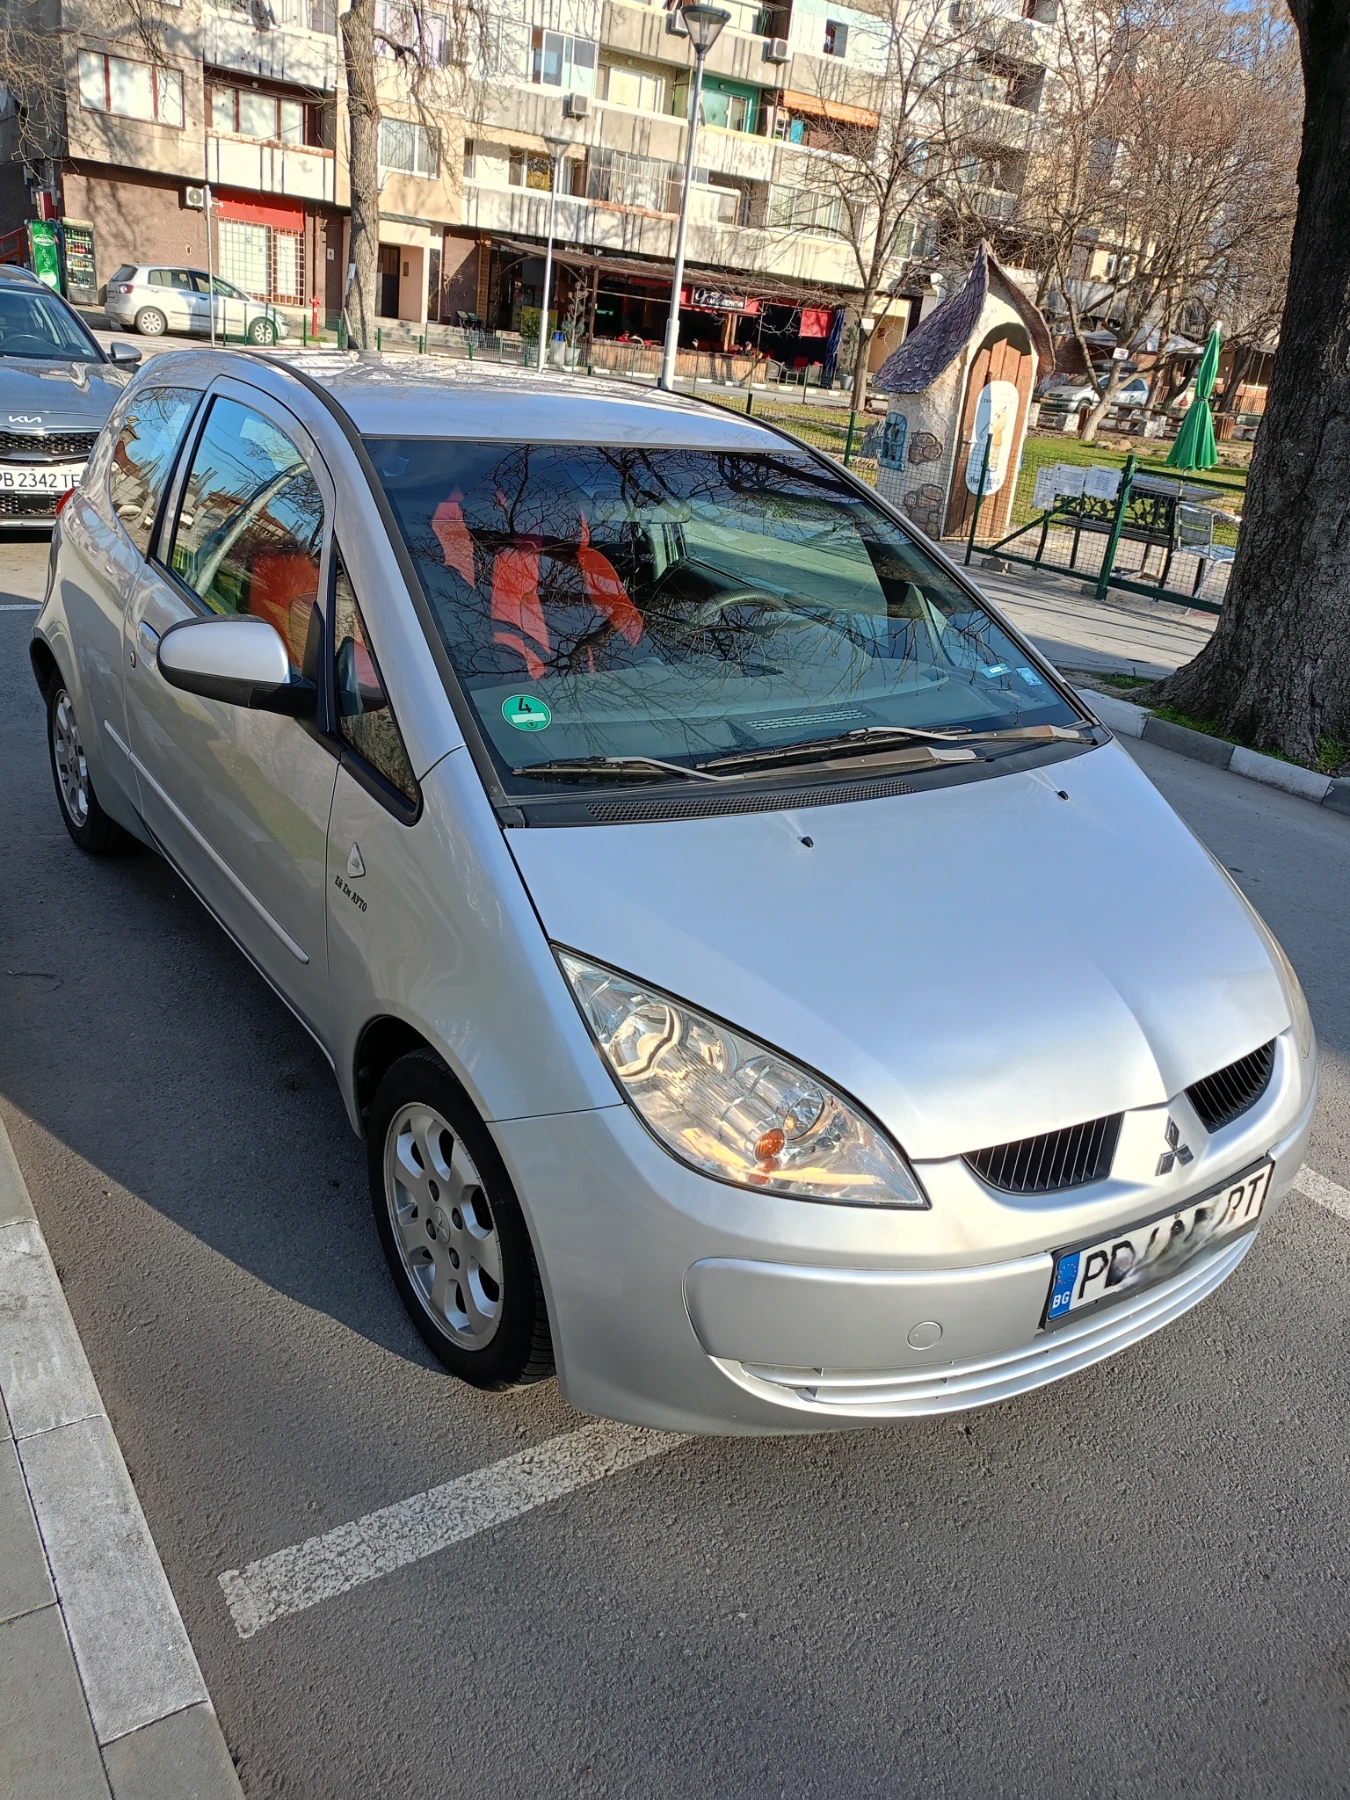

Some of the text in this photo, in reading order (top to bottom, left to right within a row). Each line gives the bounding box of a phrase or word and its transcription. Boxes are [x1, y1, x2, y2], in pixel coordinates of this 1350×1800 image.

[17, 472, 58, 488] 2342
[518, 697, 533, 713] 4
[1051, 1290, 1071, 1310] BG
